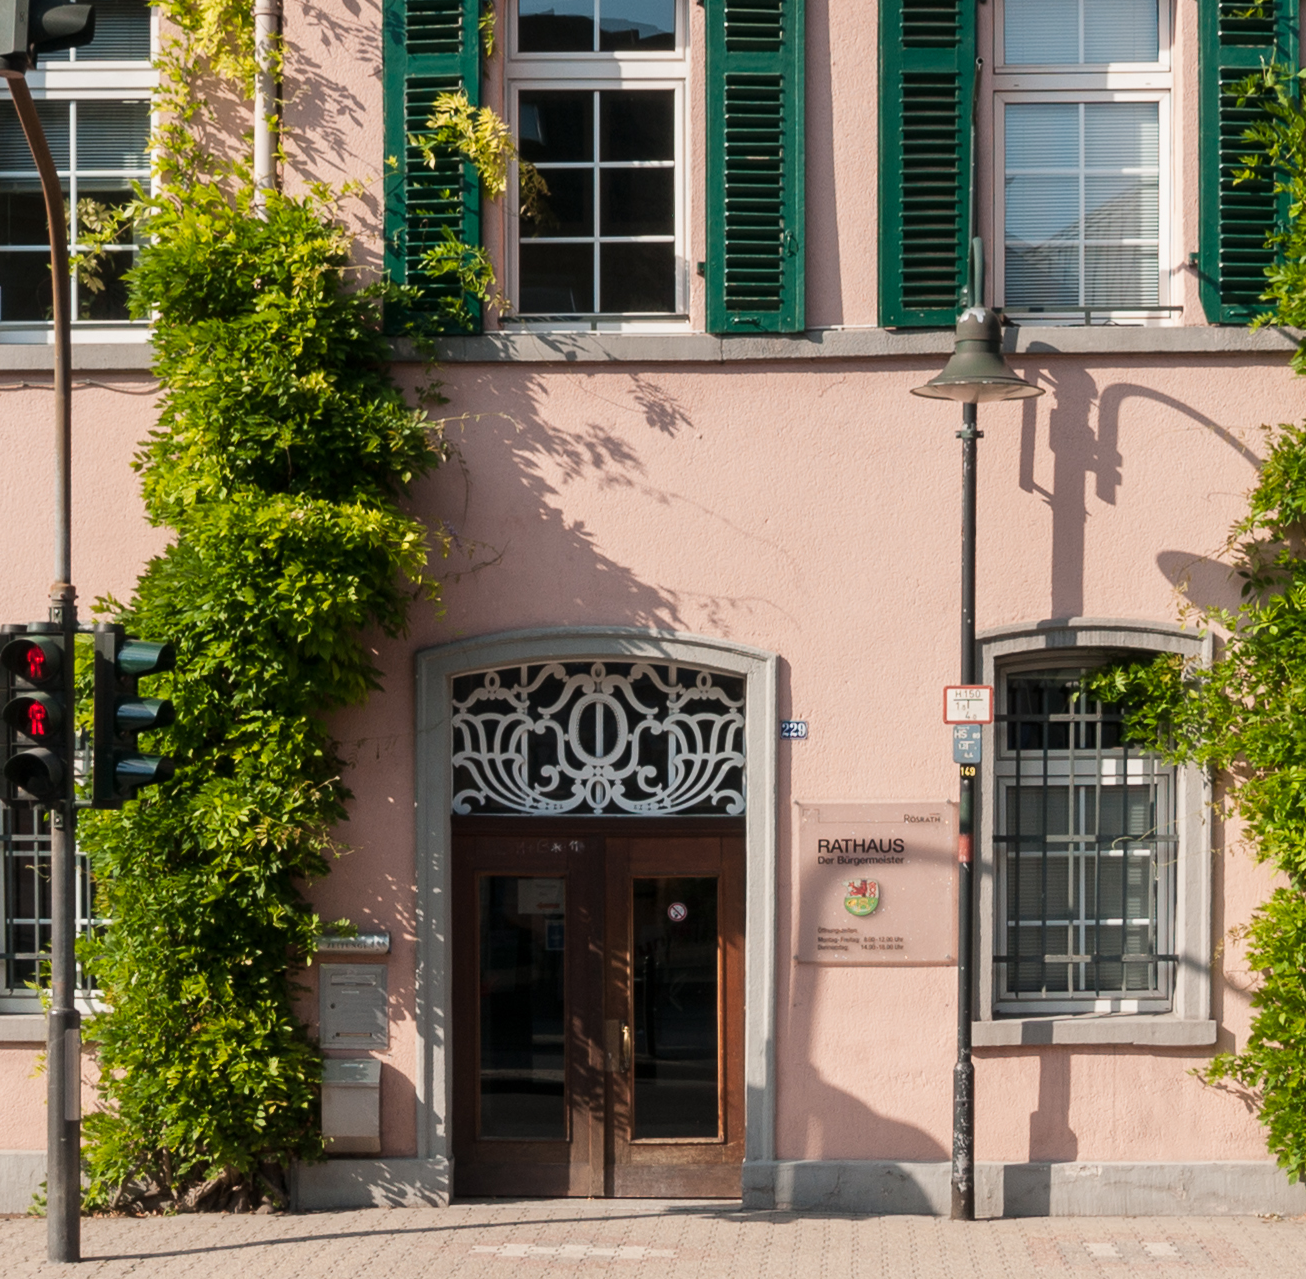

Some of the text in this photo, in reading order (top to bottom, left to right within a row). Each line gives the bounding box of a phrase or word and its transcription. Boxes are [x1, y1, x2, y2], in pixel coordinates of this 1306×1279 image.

[782, 722, 806, 737] 229
[961, 766, 976, 776] 149
[818, 838, 905, 853] RATHAUS
[818, 855, 904, 866] Der Bürgermeister
